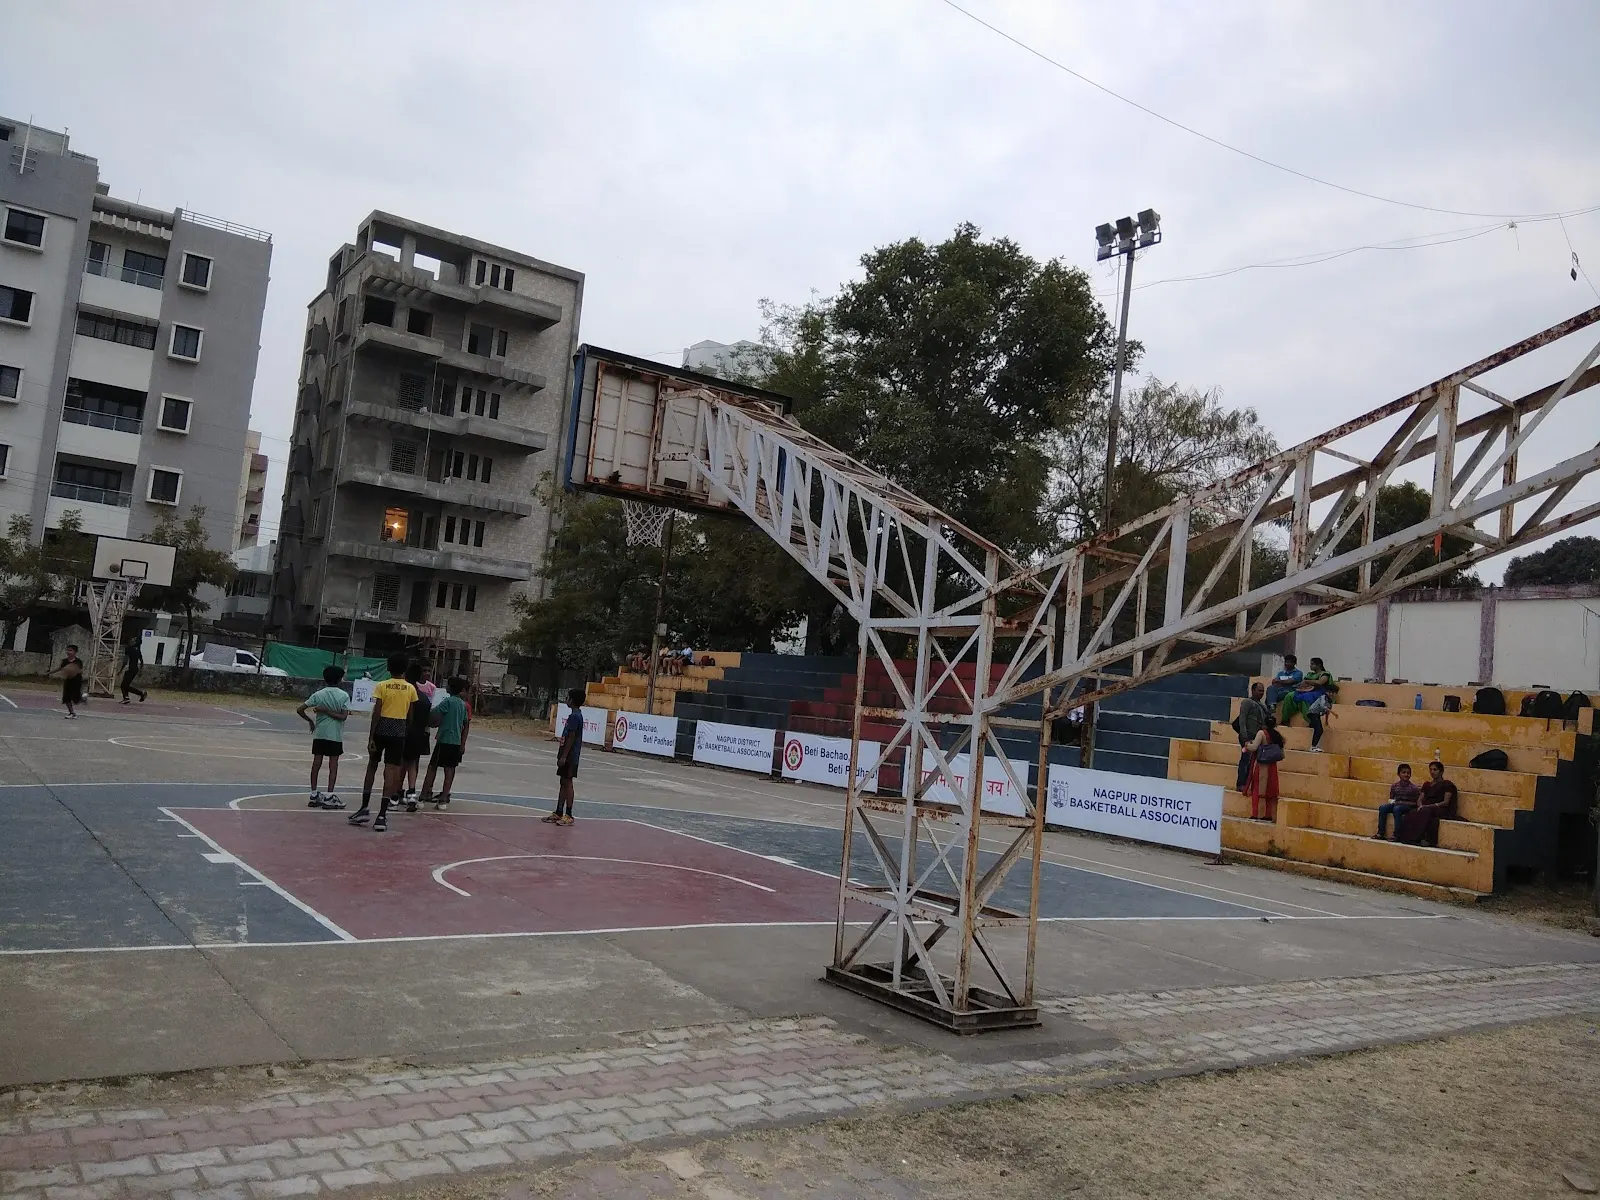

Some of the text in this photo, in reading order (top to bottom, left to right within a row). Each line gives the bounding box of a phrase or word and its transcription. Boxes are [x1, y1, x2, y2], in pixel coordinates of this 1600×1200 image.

[628, 721, 638, 731] Beti
[643, 734, 675, 747] Beti Padhao!
[716, 734, 761, 748] NAGPUR DISTRICT
[704, 742, 772, 759] BASKETBALL ASSOCIATION
[804, 745, 819, 757] Beti
[828, 763, 843, 775] Beti
[1093, 787, 1192, 812] NAGPUR DISTRICT
[1069, 797, 1218, 831] BASKETBALL ASSOCIATION
